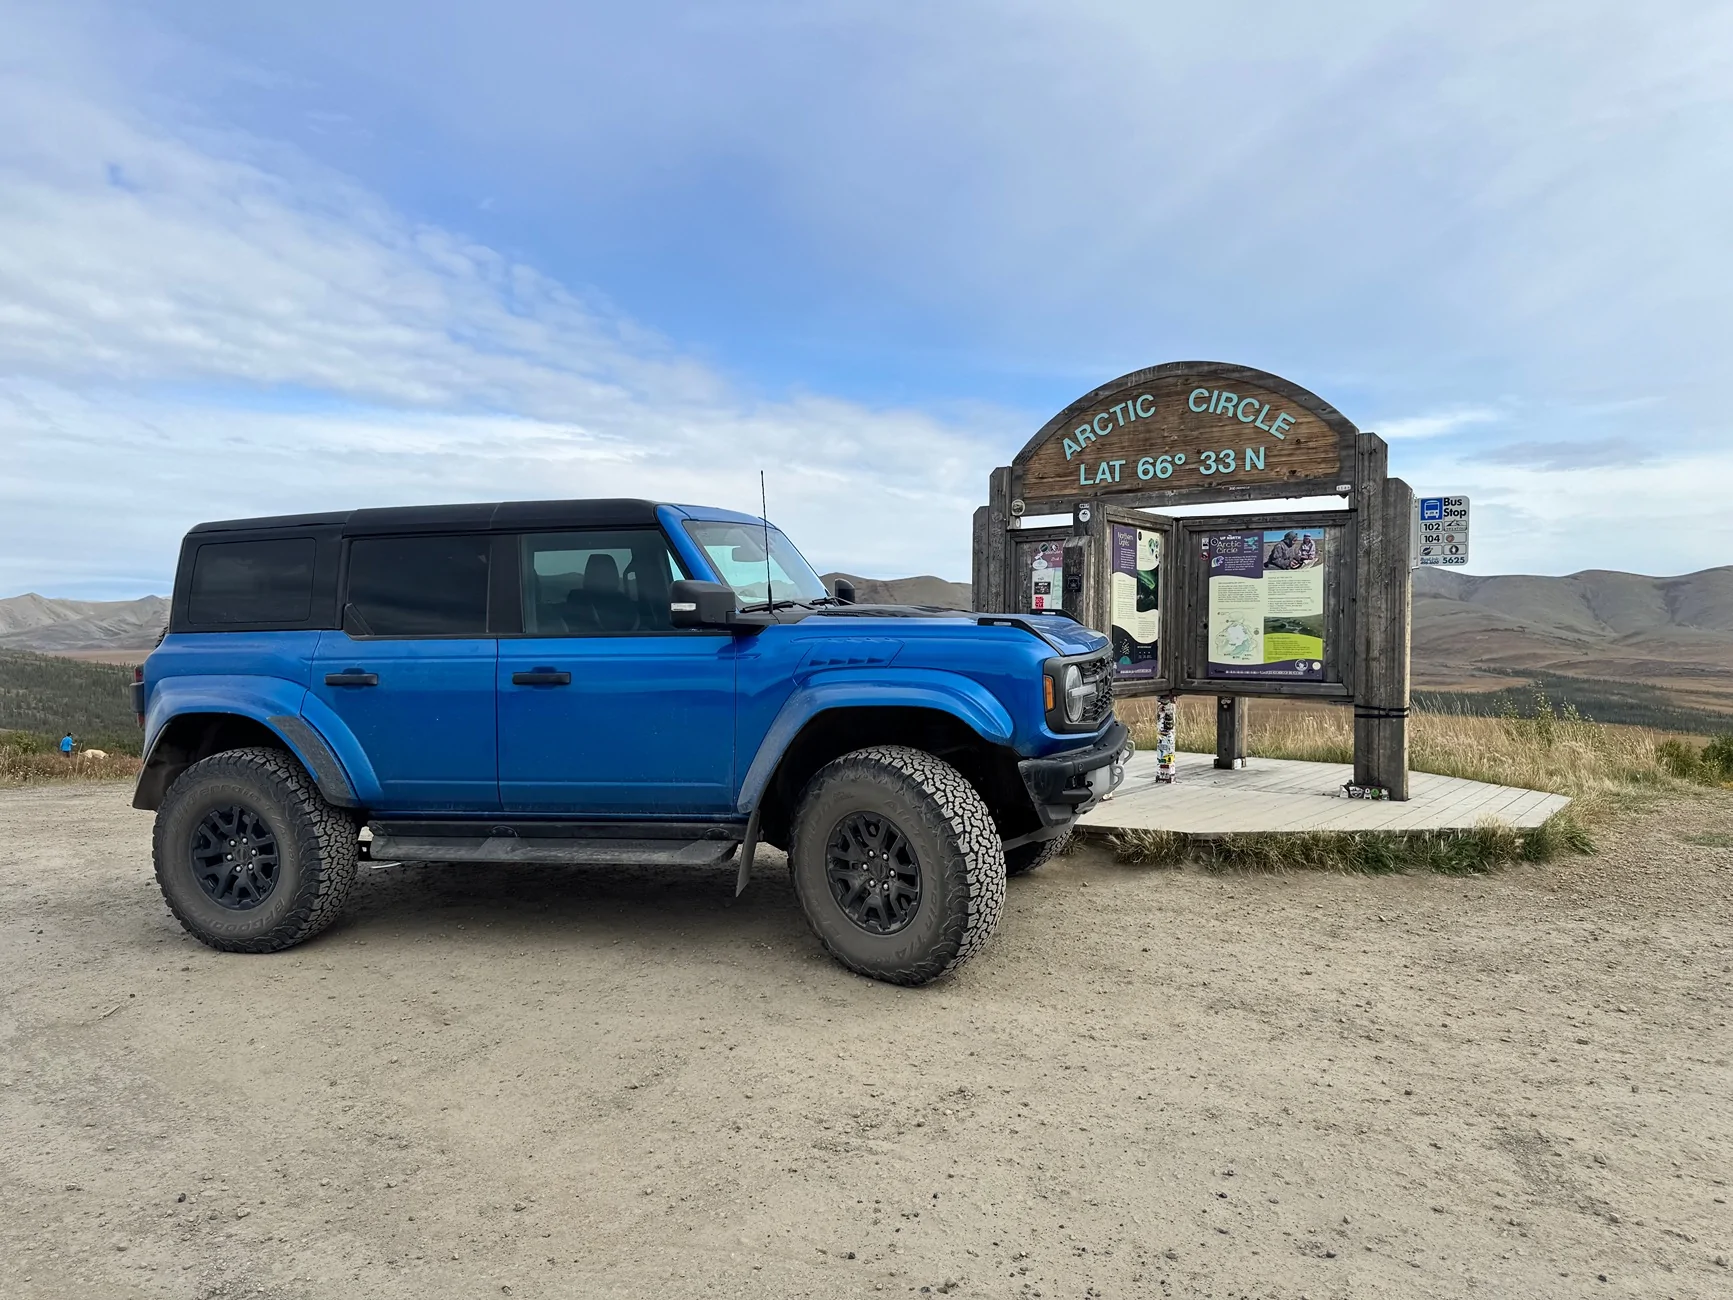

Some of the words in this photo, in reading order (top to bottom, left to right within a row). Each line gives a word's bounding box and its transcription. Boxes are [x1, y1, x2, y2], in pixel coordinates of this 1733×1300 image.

[1062, 394, 1157, 461] ARCTIC
[1188, 388, 1297, 440] CIRCLE
[1079, 459, 1126, 486] LAT
[1137, 453, 1186, 480] 66°
[1199, 449, 1236, 475] 33
[1245, 446, 1265, 471] N
[1443, 497, 1462, 506] Bus
[1443, 508, 1466, 518] Stop
[1424, 522, 1440, 531] 102
[1424, 535, 1440, 543] 104
[1217, 540, 1242, 549] Arctic
[1216, 546, 1239, 555] Circle
[1442, 556, 1465, 564] 5625
